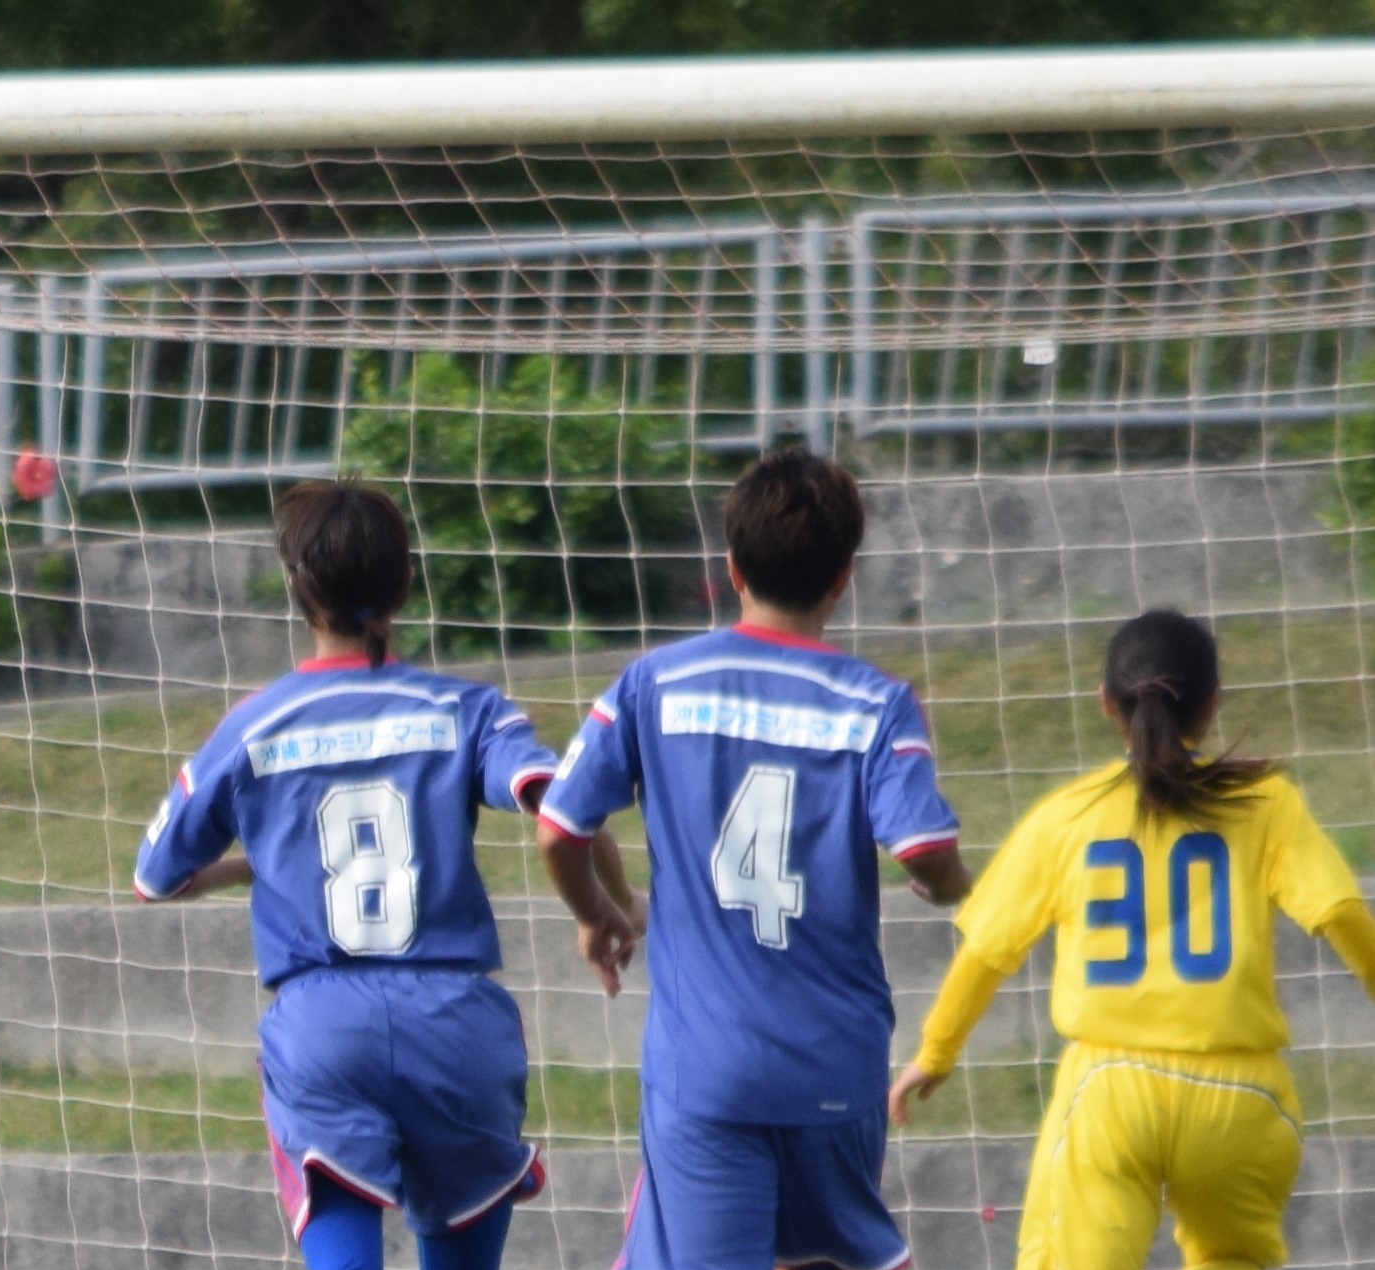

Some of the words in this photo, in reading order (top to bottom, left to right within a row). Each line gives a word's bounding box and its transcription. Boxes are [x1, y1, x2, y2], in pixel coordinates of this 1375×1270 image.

[262, 721, 447, 768] 沖縄ファミリーマート
[316, 779, 419, 956] 8
[711, 764, 803, 950] 4
[1085, 831, 1233, 986] 30
